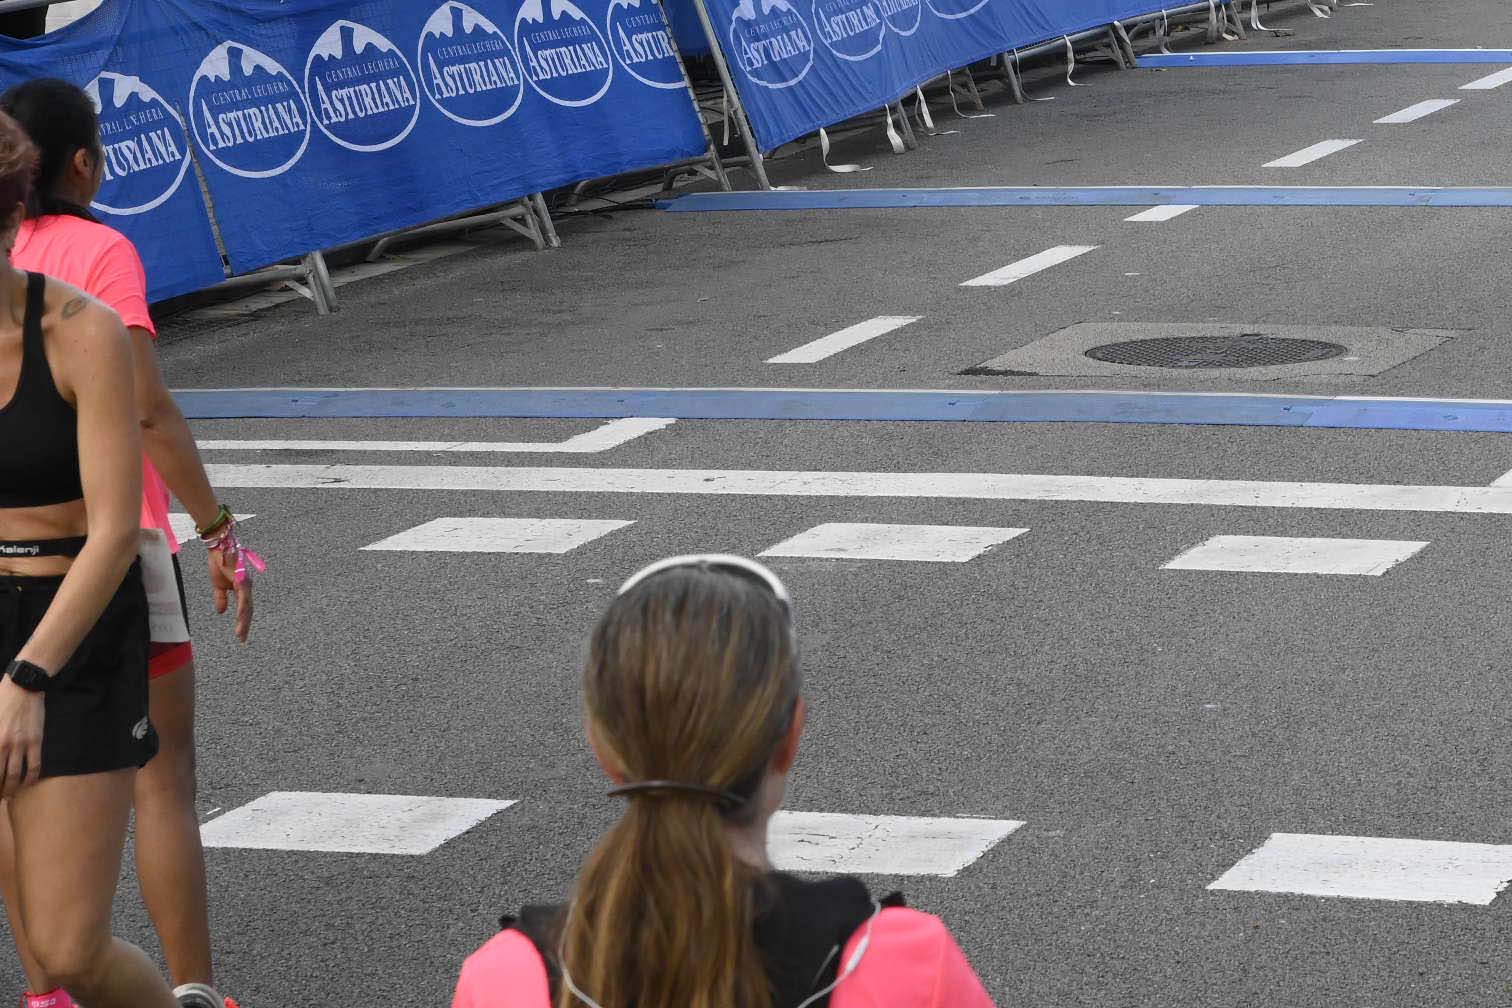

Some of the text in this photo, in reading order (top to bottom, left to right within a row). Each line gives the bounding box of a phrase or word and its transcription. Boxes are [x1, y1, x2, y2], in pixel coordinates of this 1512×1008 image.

[438, 39, 504, 59] CENTRAL LECHERA
[531, 25, 592, 44] CENTRAL LECHERA
[325, 57, 400, 82] CENTRAL LECHERA
[427, 52, 520, 100] ASTURIANA
[523, 36, 608, 81] ASTURIANA
[212, 81, 289, 105] CENTRAL LECHERA
[315, 75, 415, 125] ASTURIANA
[201, 97, 305, 151] ASTURIANA
